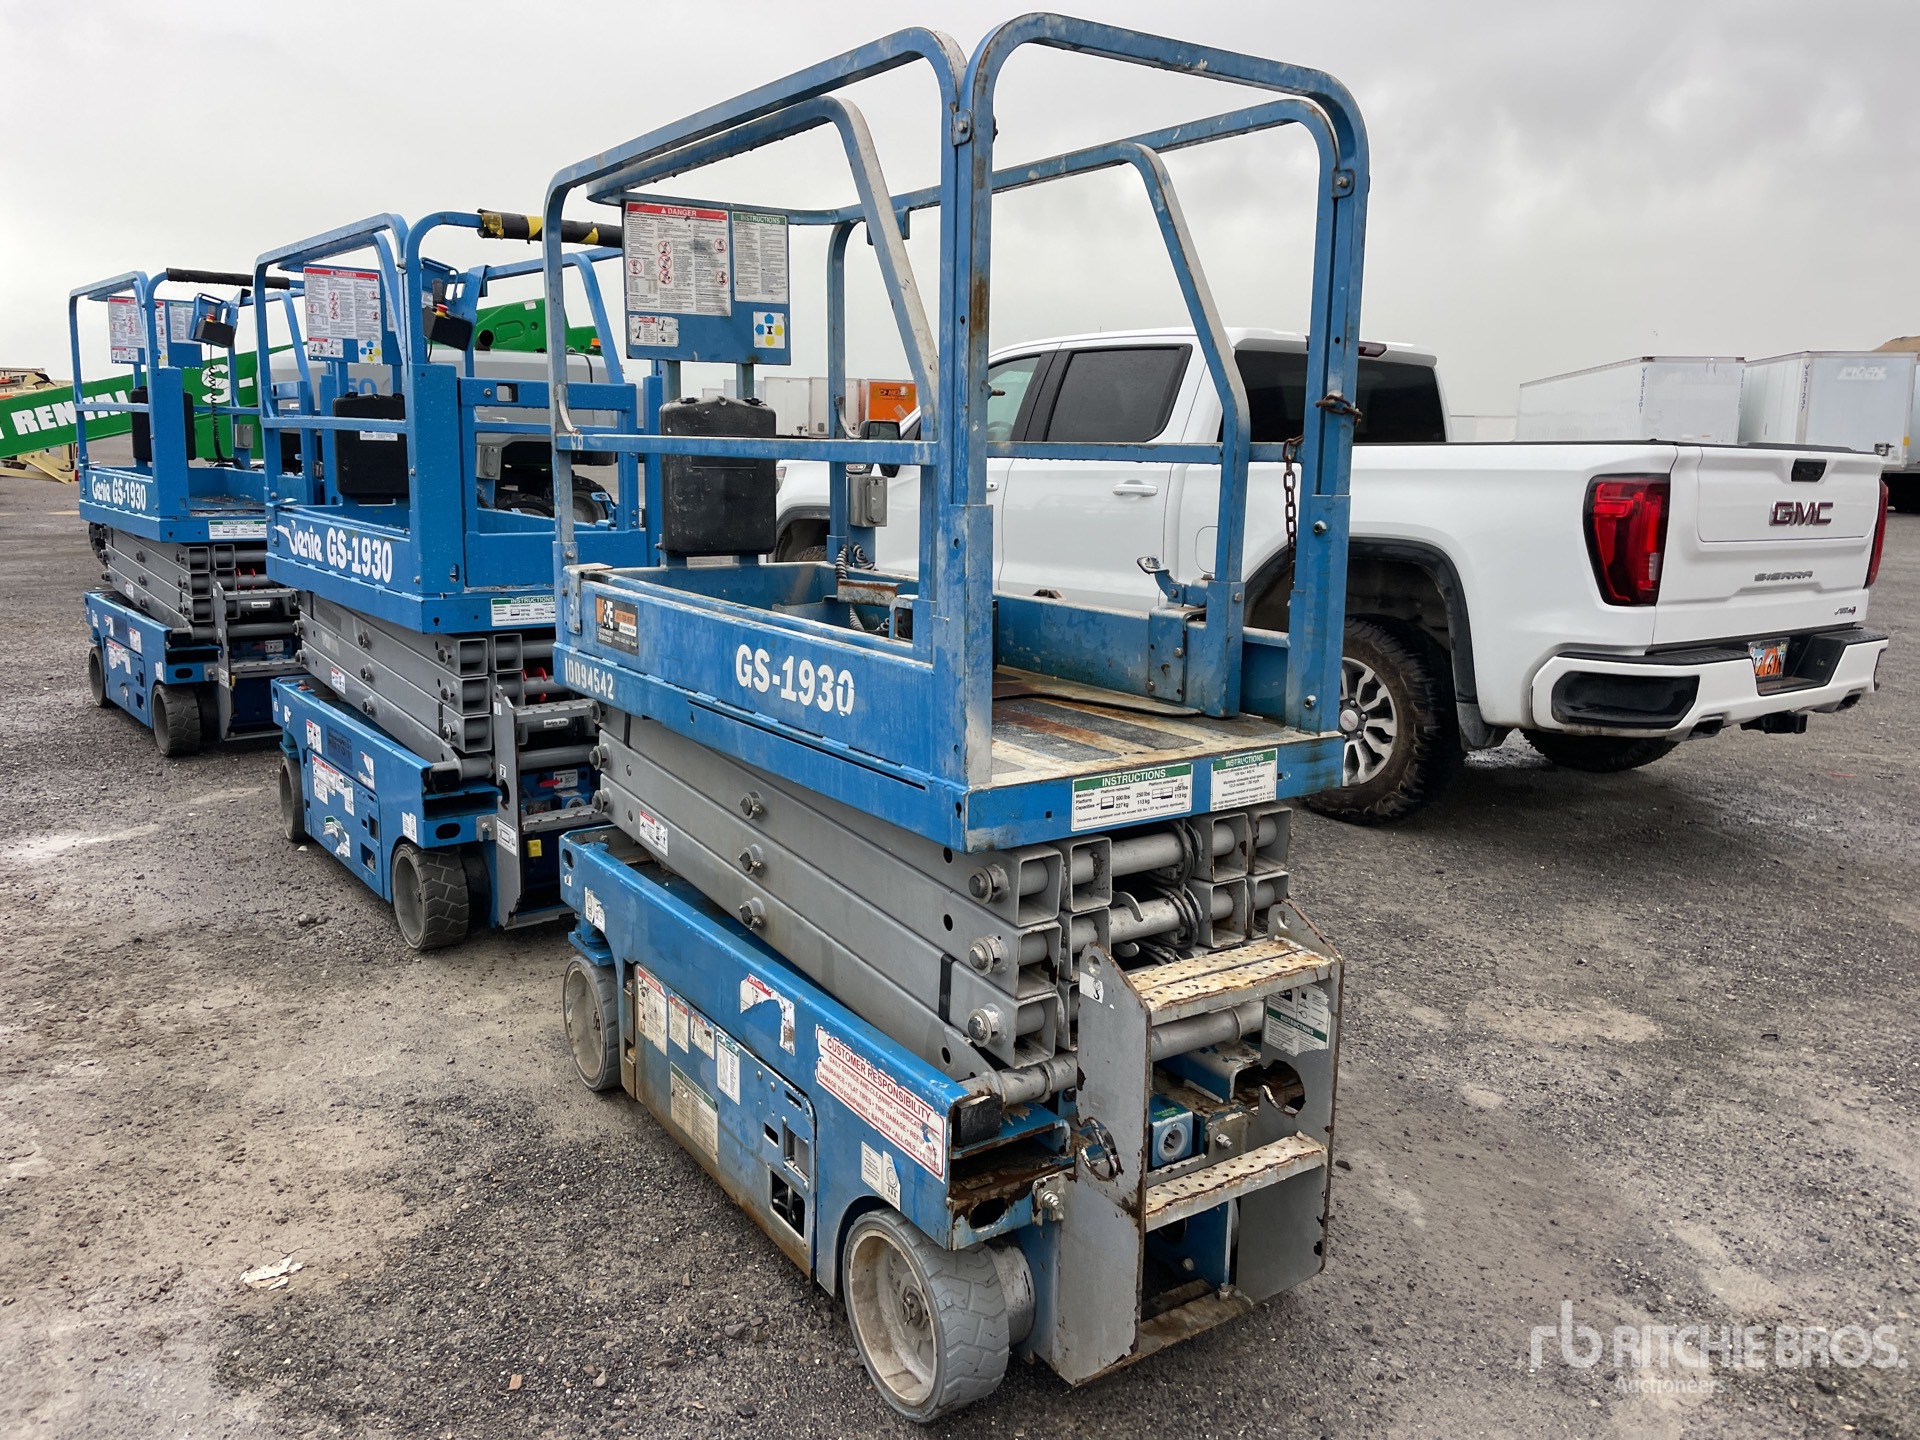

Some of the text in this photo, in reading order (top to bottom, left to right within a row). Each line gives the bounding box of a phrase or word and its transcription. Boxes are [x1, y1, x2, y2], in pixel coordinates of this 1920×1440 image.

[667, 207, 697, 217] DANGER
[740, 214, 780, 224] INSTRUCTIONS
[91, 474, 147, 511] Genie GS-1930
[1769, 501, 1834, 527] GMC
[326, 527, 393, 583] GS-1930
[1754, 571, 1814, 582] SIERRA
[564, 657, 614, 700] 10094542
[735, 644, 855, 716] GS-1930
[1101, 769, 1166, 787] INSTRUCTIONS
[1225, 754, 1264, 767] INSTRUCTIONS
[821, 1062, 845, 1085] INSURANCE
[847, 1082, 859, 1094] FLAT
[859, 1091, 872, 1106] TIRES
[875, 1103, 885, 1117] TIRE
[885, 1111, 906, 1132] DAMAGE
[827, 1038, 931, 1122] CUSTOMER RESPONSIBILITY
[829, 1055, 841, 1069] DAILY
[841, 1063, 859, 1083] SERVICE
[869, 1083, 893, 1109] CLEANING
[819, 1072, 837, 1090] DAMAGE
[837, 1085, 844, 1095] TO
[844, 1090, 868, 1115] EQUIPMENT
[871, 1112, 892, 1134] BATTERY
[894, 1130, 904, 1144] ALL
